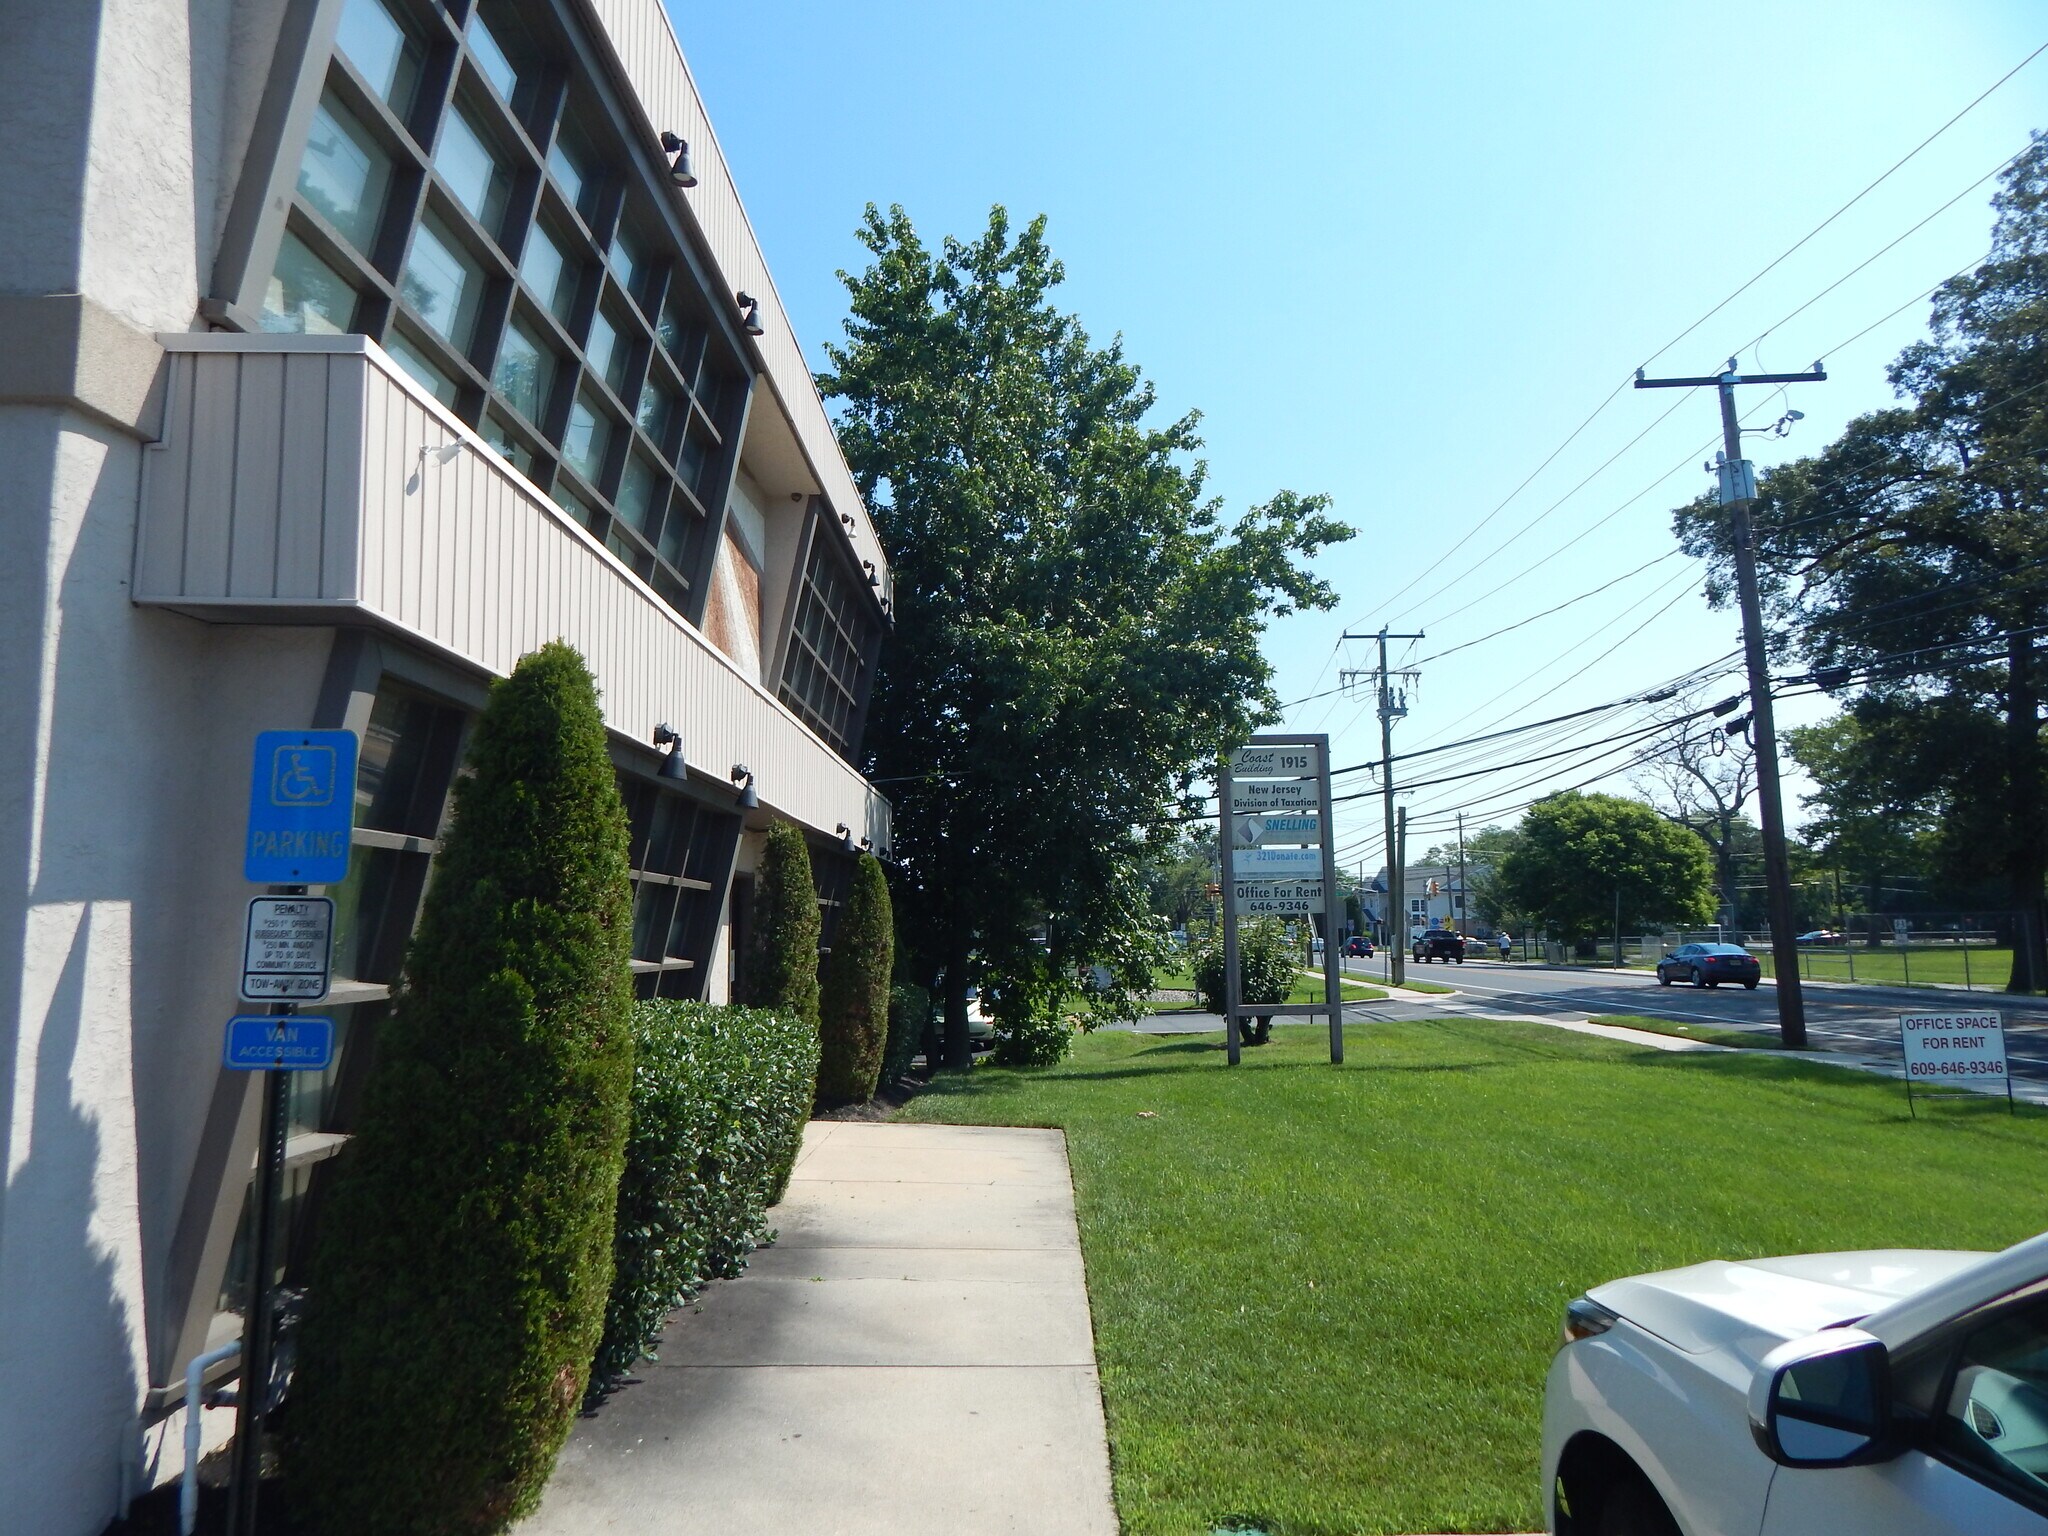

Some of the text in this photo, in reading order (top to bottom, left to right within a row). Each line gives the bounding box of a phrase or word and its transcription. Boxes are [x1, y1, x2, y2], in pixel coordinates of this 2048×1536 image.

[1242, 750, 1307, 768] Coast 1915
[1234, 763, 1273, 774] Building
[1248, 785, 1302, 795] New Jersey
[1234, 798, 1317, 807] Division of Taxation
[1266, 819, 1316, 831] SNELLING
[252, 831, 344, 858] PARKING
[1237, 886, 1322, 898] Office For Rent
[274, 904, 309, 914] PENALTY
[1250, 902, 1308, 911] 646-9346
[294, 961, 317, 969] SERVICE
[250, 979, 320, 989] TOW-AWAY ZONE
[1906, 1017, 1998, 1030] OFFICE SPACE
[265, 1027, 299, 1042] VAN
[1922, 1036, 1985, 1049] FOR RENT
[239, 1046, 320, 1058] ACCESSIBLE
[1911, 1061, 2004, 1075] 609-646-9346
